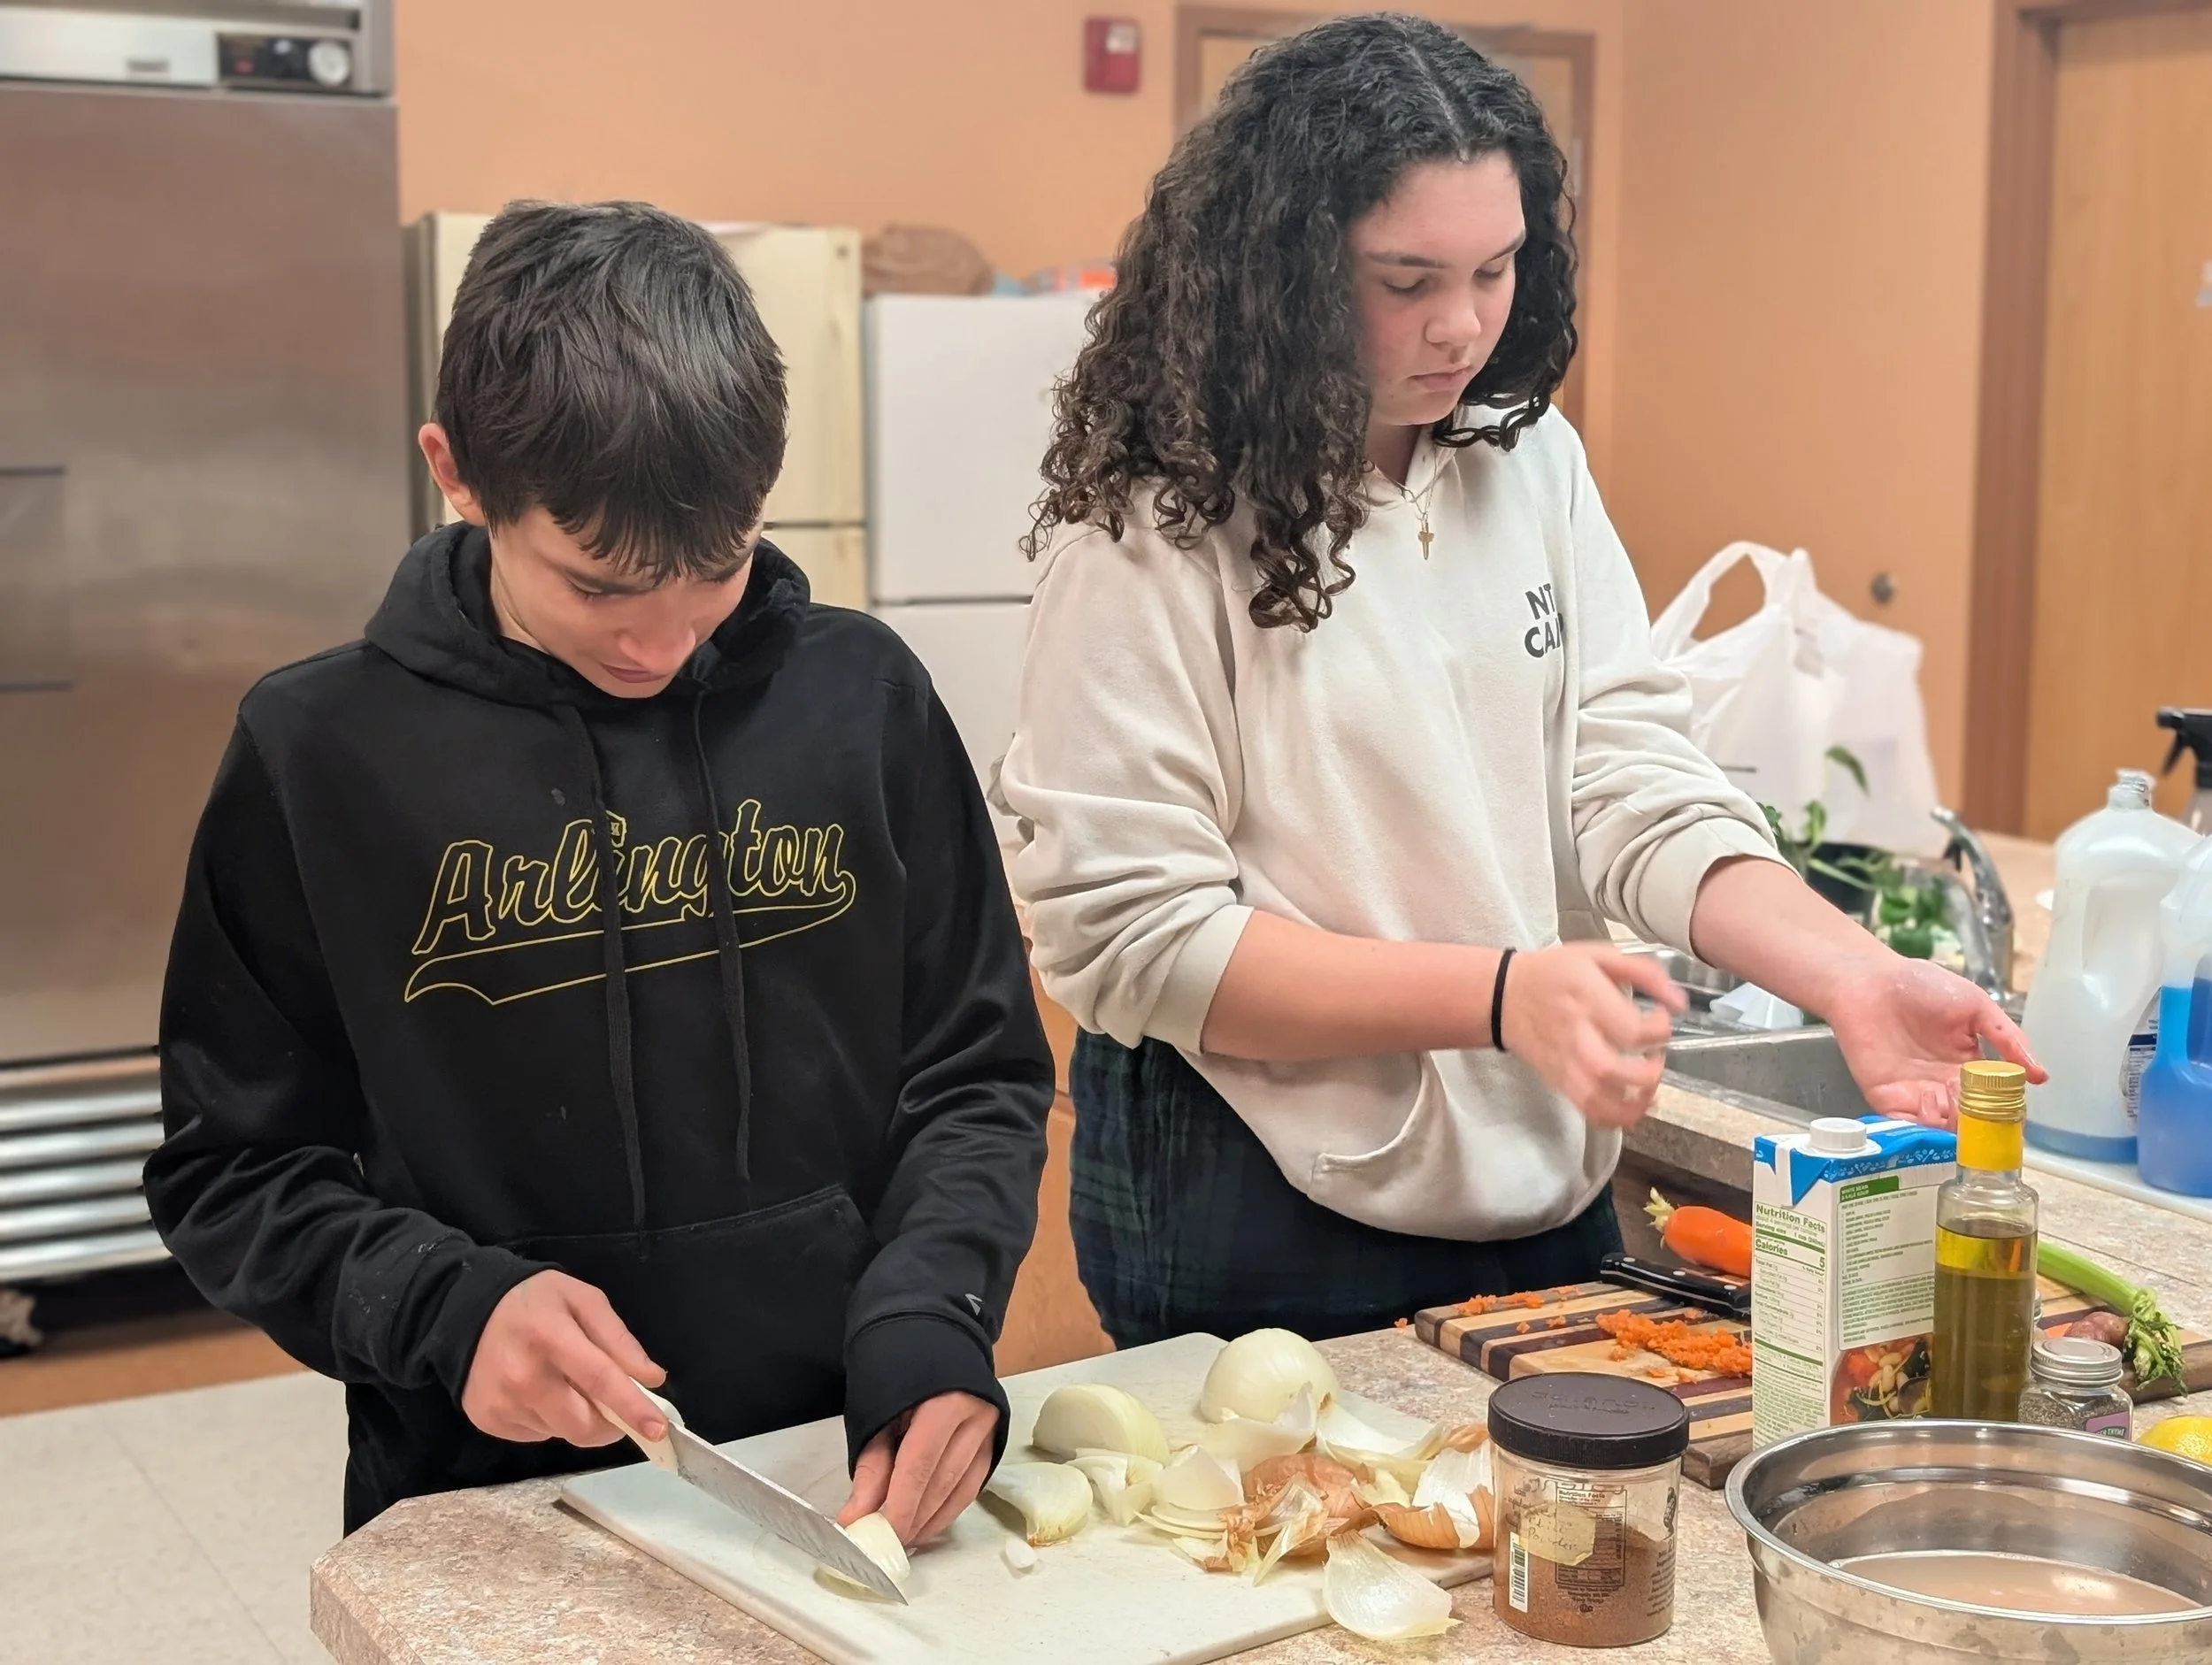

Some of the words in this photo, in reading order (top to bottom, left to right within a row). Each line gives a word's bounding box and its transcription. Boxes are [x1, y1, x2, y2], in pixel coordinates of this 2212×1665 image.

[411, 799, 849, 955] Arlington
[1756, 1204, 1801, 1224] Nutrition
[1803, 1217, 1825, 1233] Facts
[1755, 1239, 1788, 1255] Calories
[1819, 1256, 1825, 1269] 5
